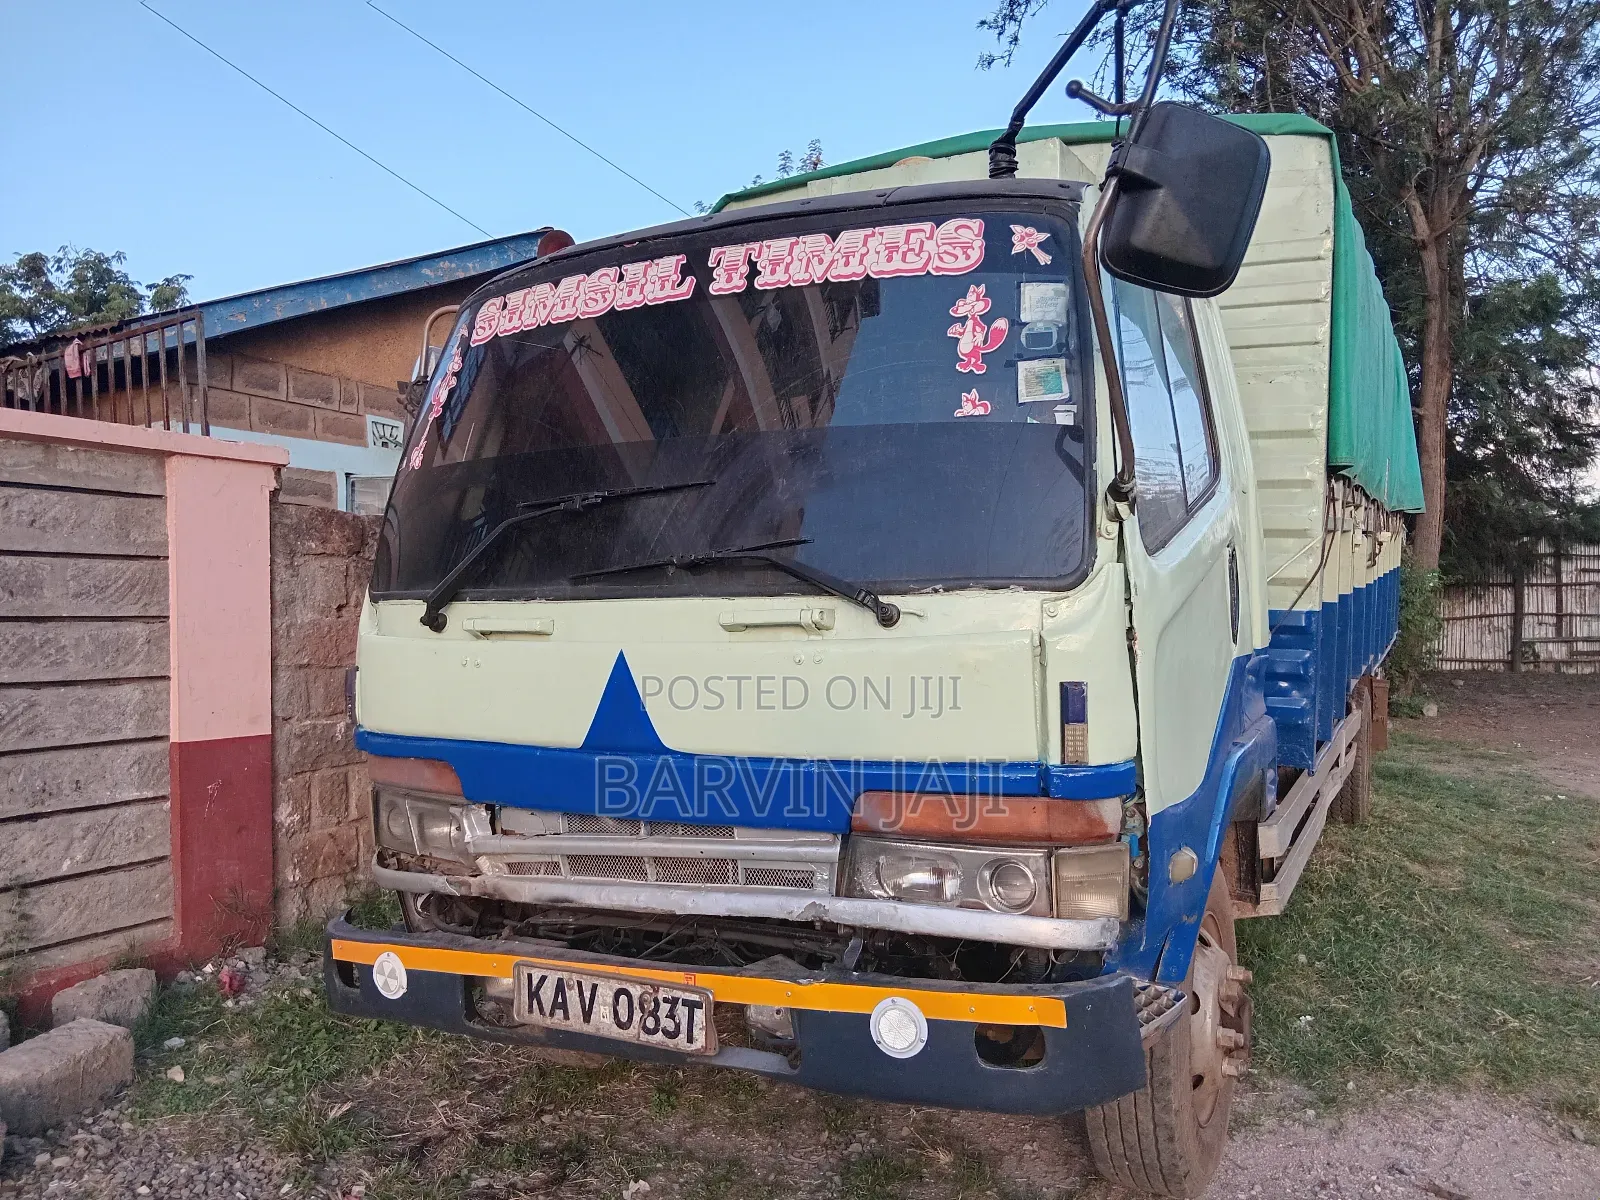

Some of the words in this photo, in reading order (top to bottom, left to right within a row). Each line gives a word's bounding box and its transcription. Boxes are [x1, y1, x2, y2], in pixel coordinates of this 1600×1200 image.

[470, 254, 697, 347] SIMSIL
[708, 218, 985, 295] TIMES
[526, 973, 599, 1024] KAV
[612, 988, 704, 1044] 083T
